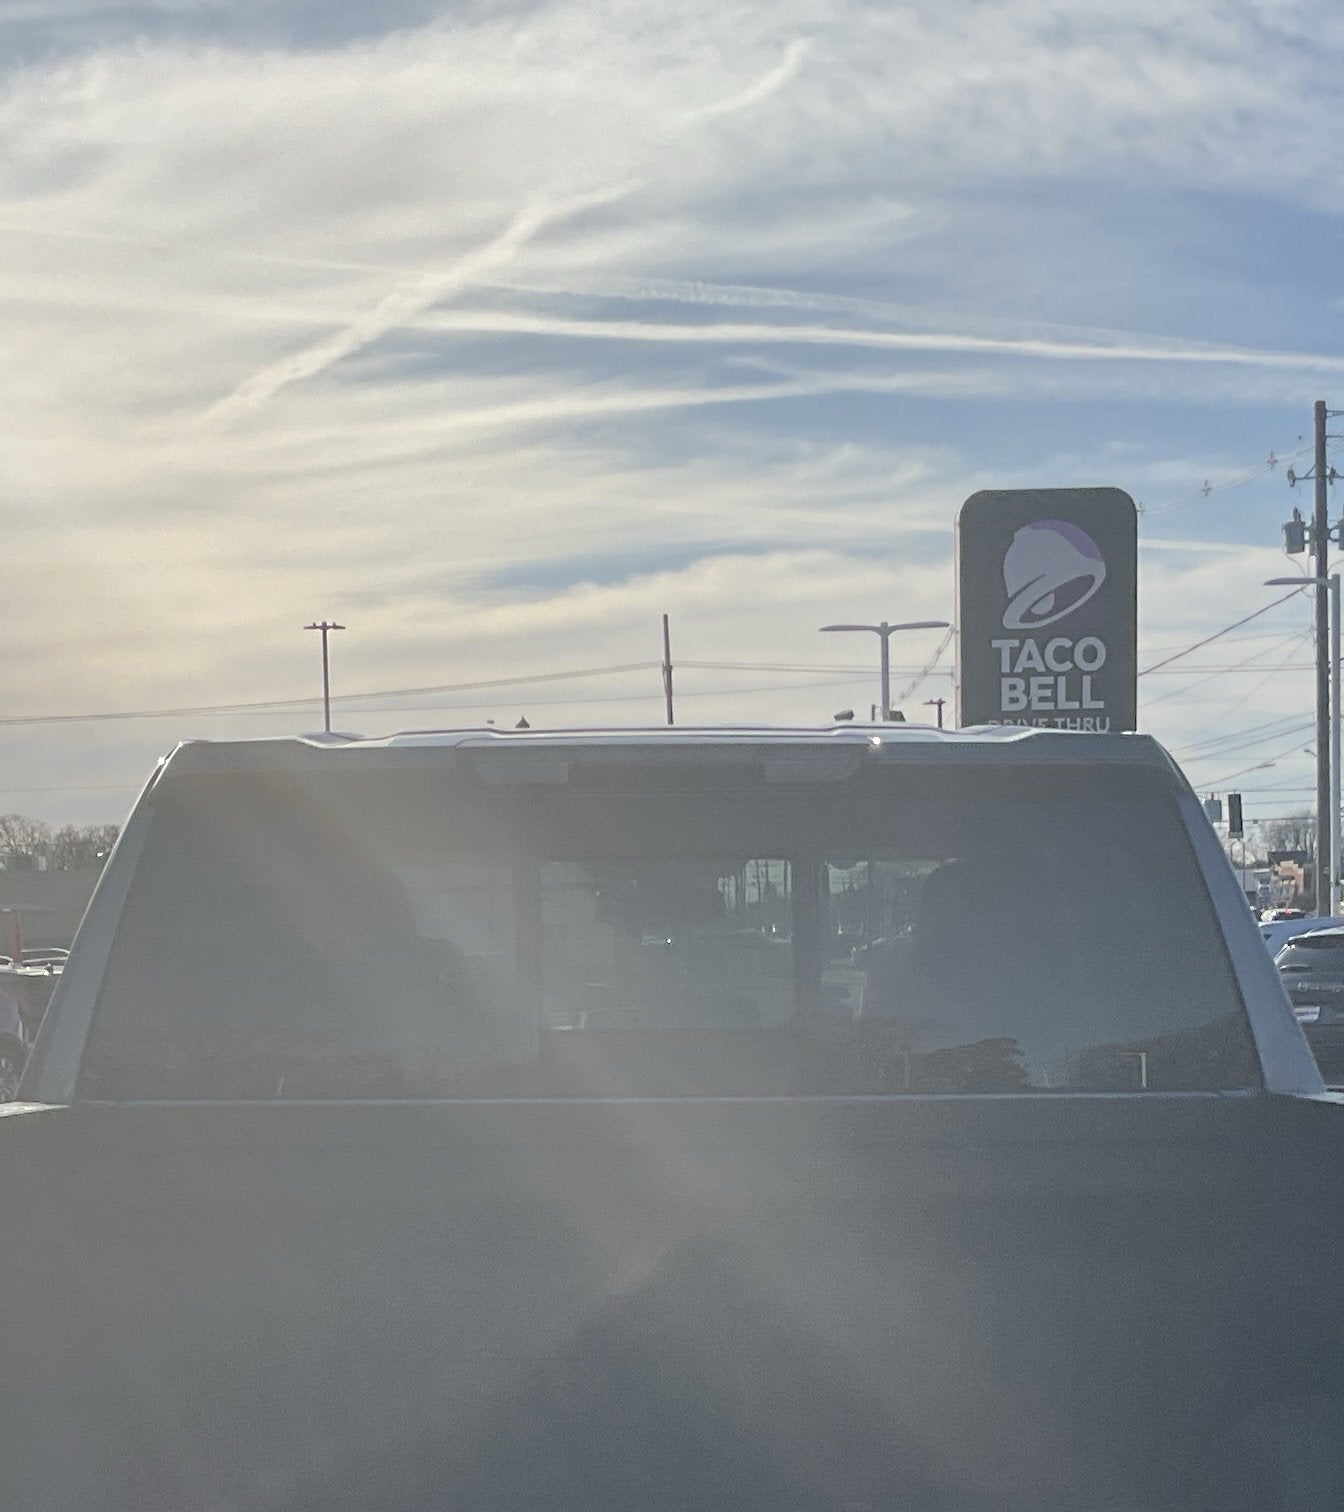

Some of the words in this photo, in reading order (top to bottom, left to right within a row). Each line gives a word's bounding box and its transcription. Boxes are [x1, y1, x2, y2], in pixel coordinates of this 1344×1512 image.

[991, 637, 1106, 673] TACO
[1001, 675, 1104, 711] BELL
[1054, 716, 1110, 732] THRU
